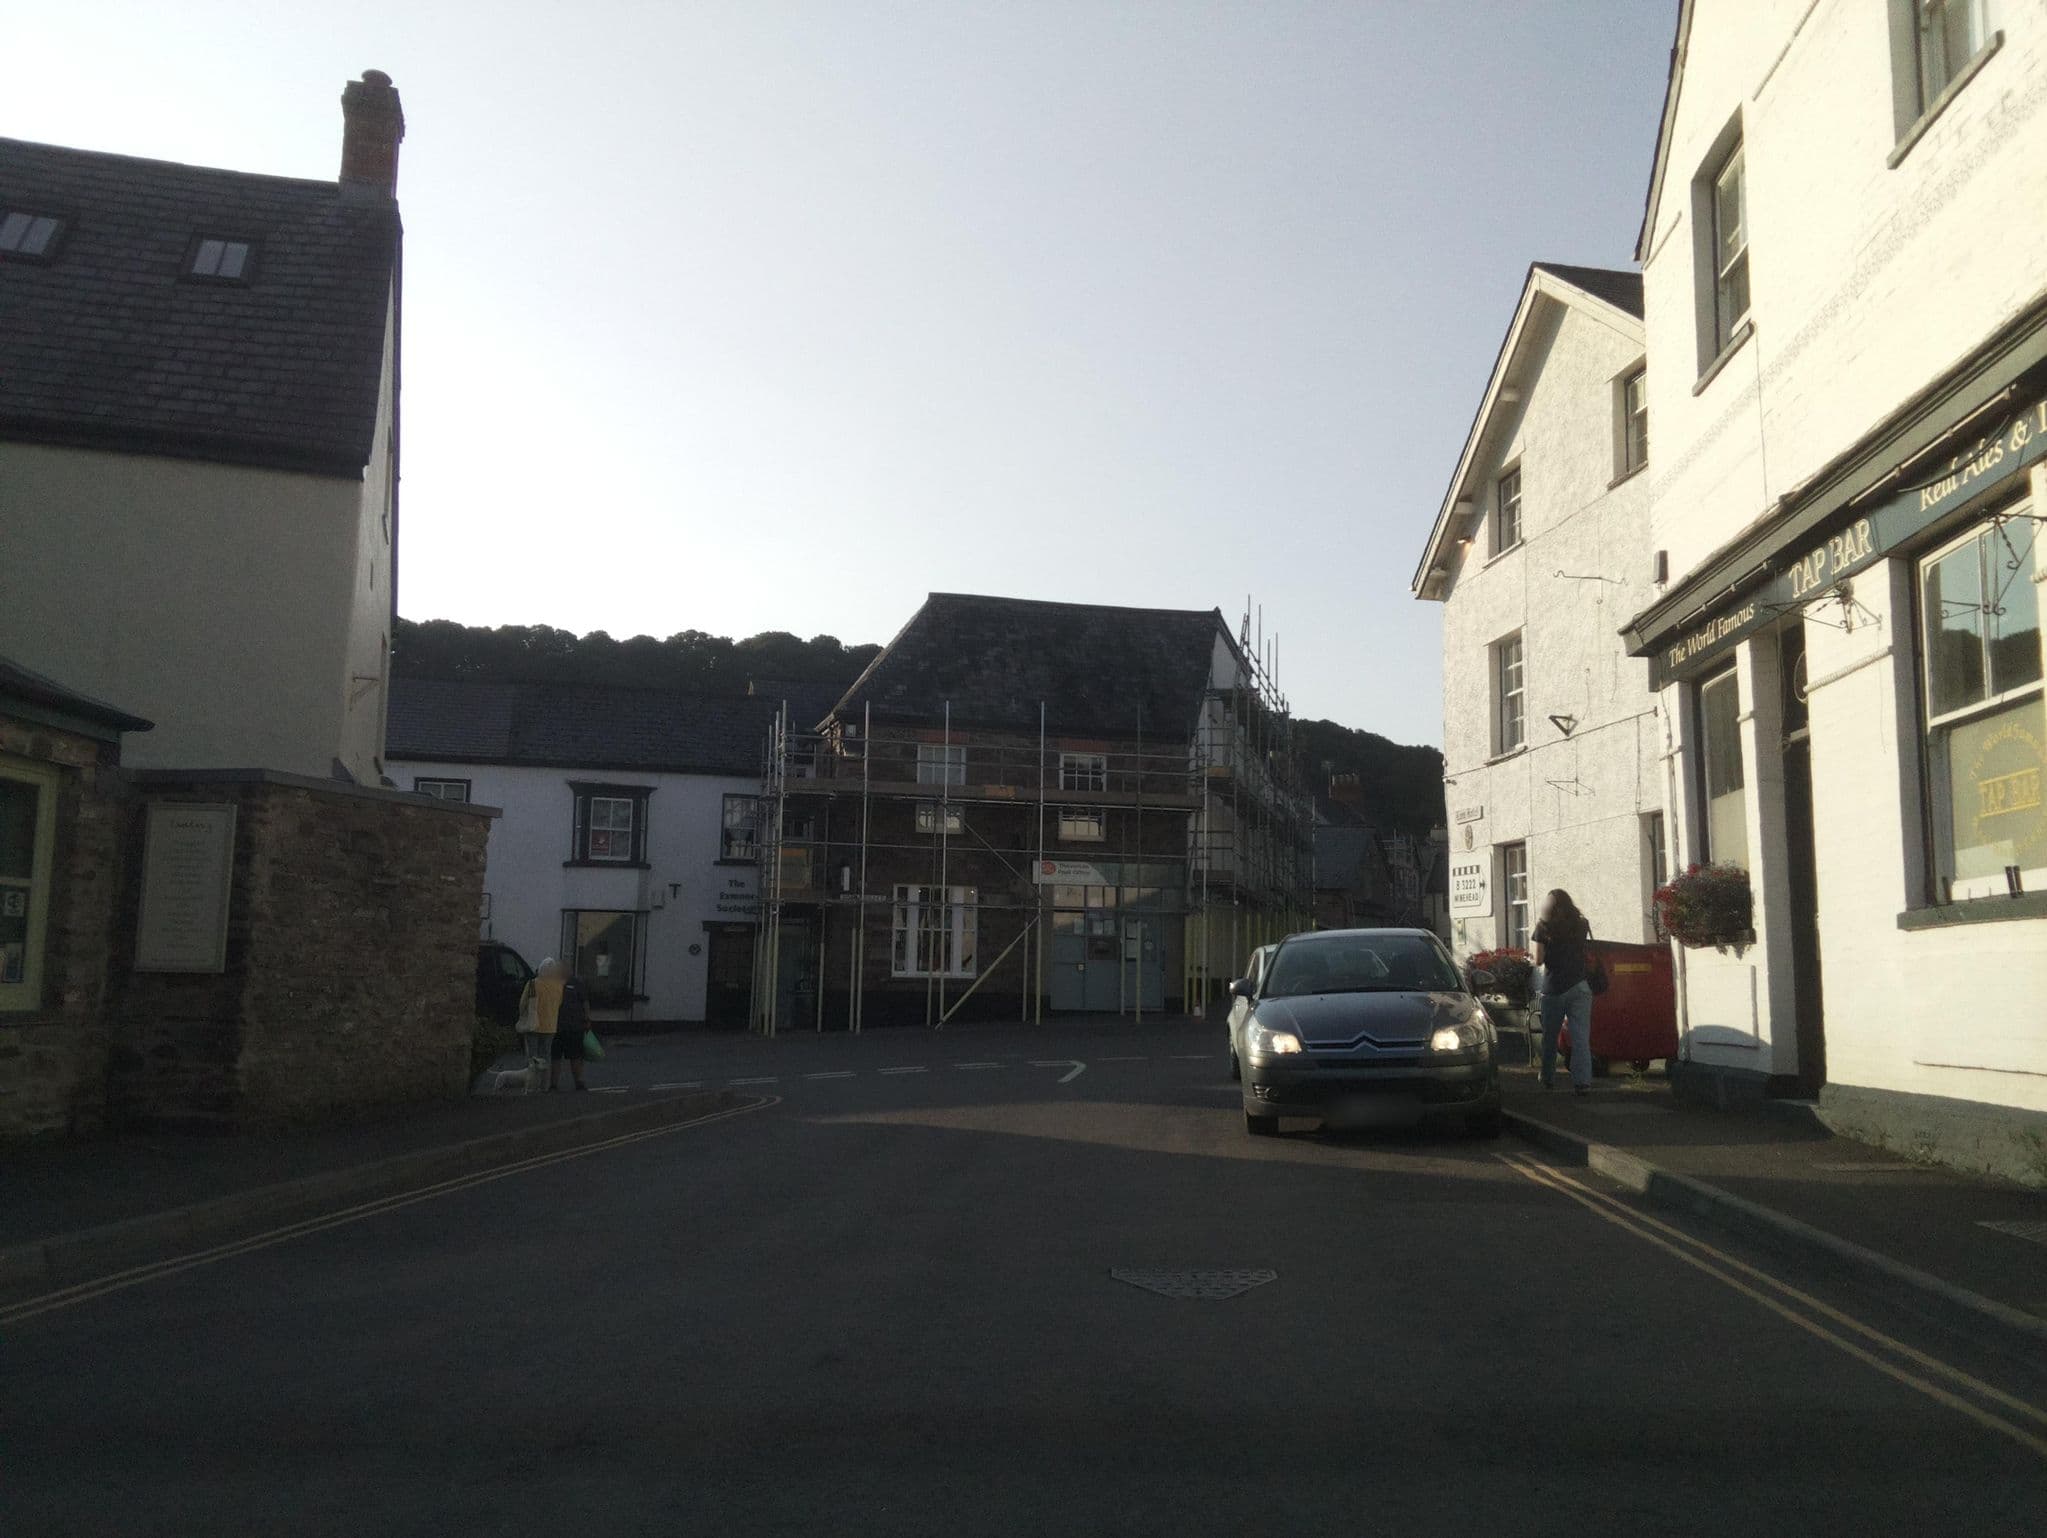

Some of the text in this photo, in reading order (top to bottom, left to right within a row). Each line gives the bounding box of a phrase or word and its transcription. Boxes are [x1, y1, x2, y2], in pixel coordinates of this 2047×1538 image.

[2010, 417, 2033, 452] &
[1788, 518, 1873, 599] TAP BAR
[1669, 603, 1755, 668] The World Famous
